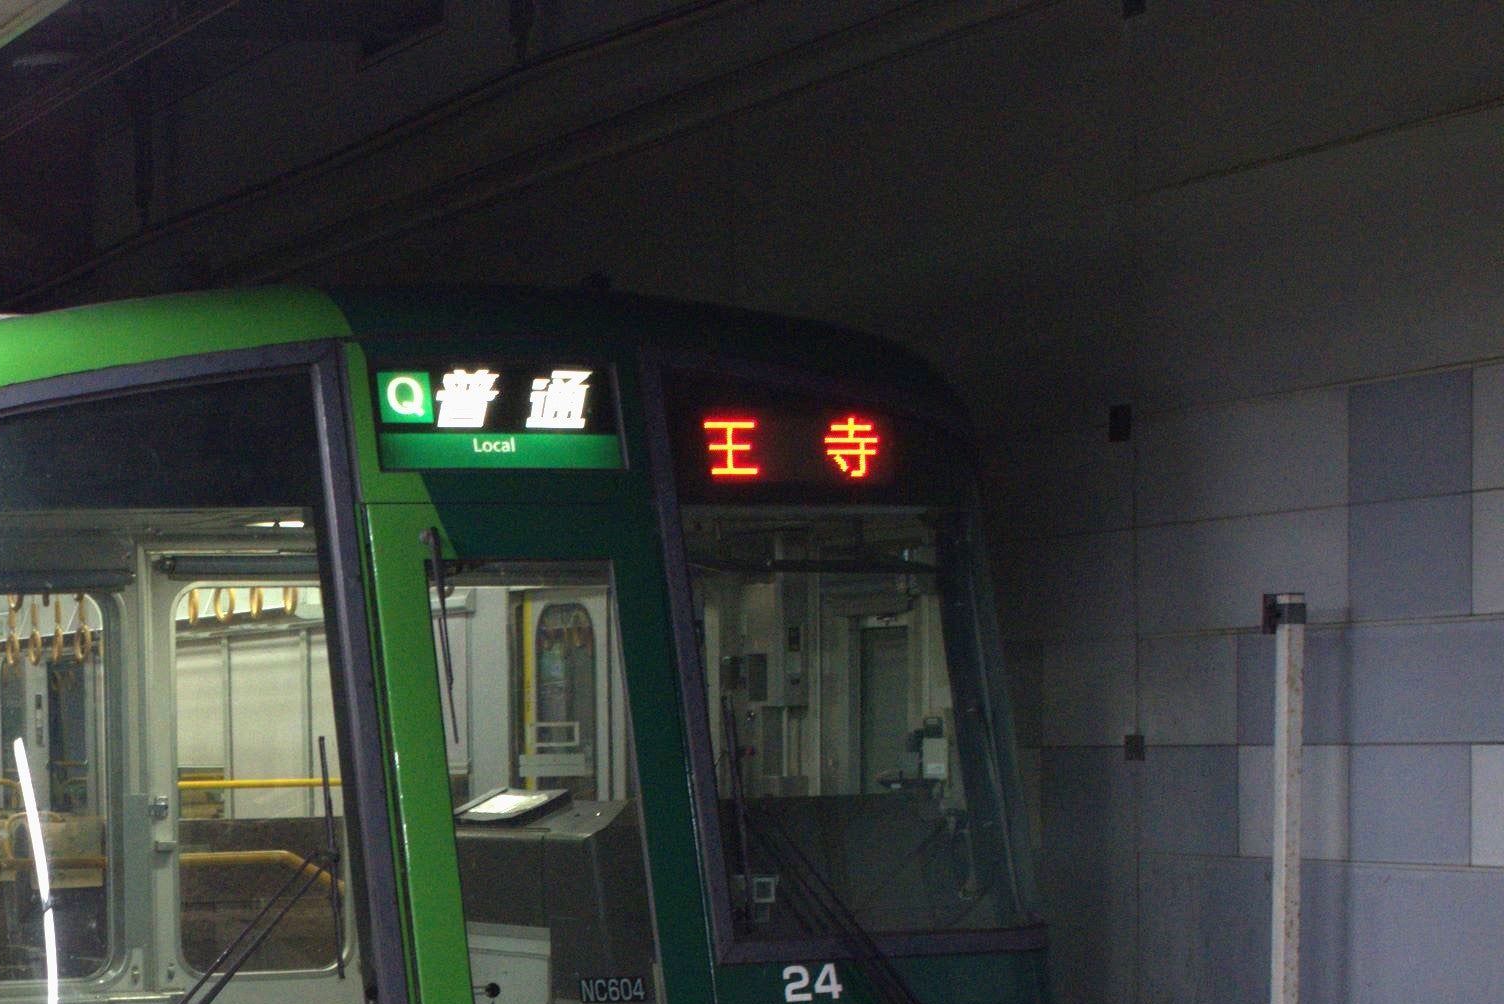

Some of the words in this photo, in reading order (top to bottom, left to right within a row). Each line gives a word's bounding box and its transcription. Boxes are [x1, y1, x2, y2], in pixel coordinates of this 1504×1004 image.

[386, 376, 425, 417] Q
[435, 369, 593, 429] 普通
[472, 437, 516, 453] Local
[703, 415, 880, 479] 王寺
[579, 976, 647, 1003] NC604
[782, 962, 844, 1003] 24
